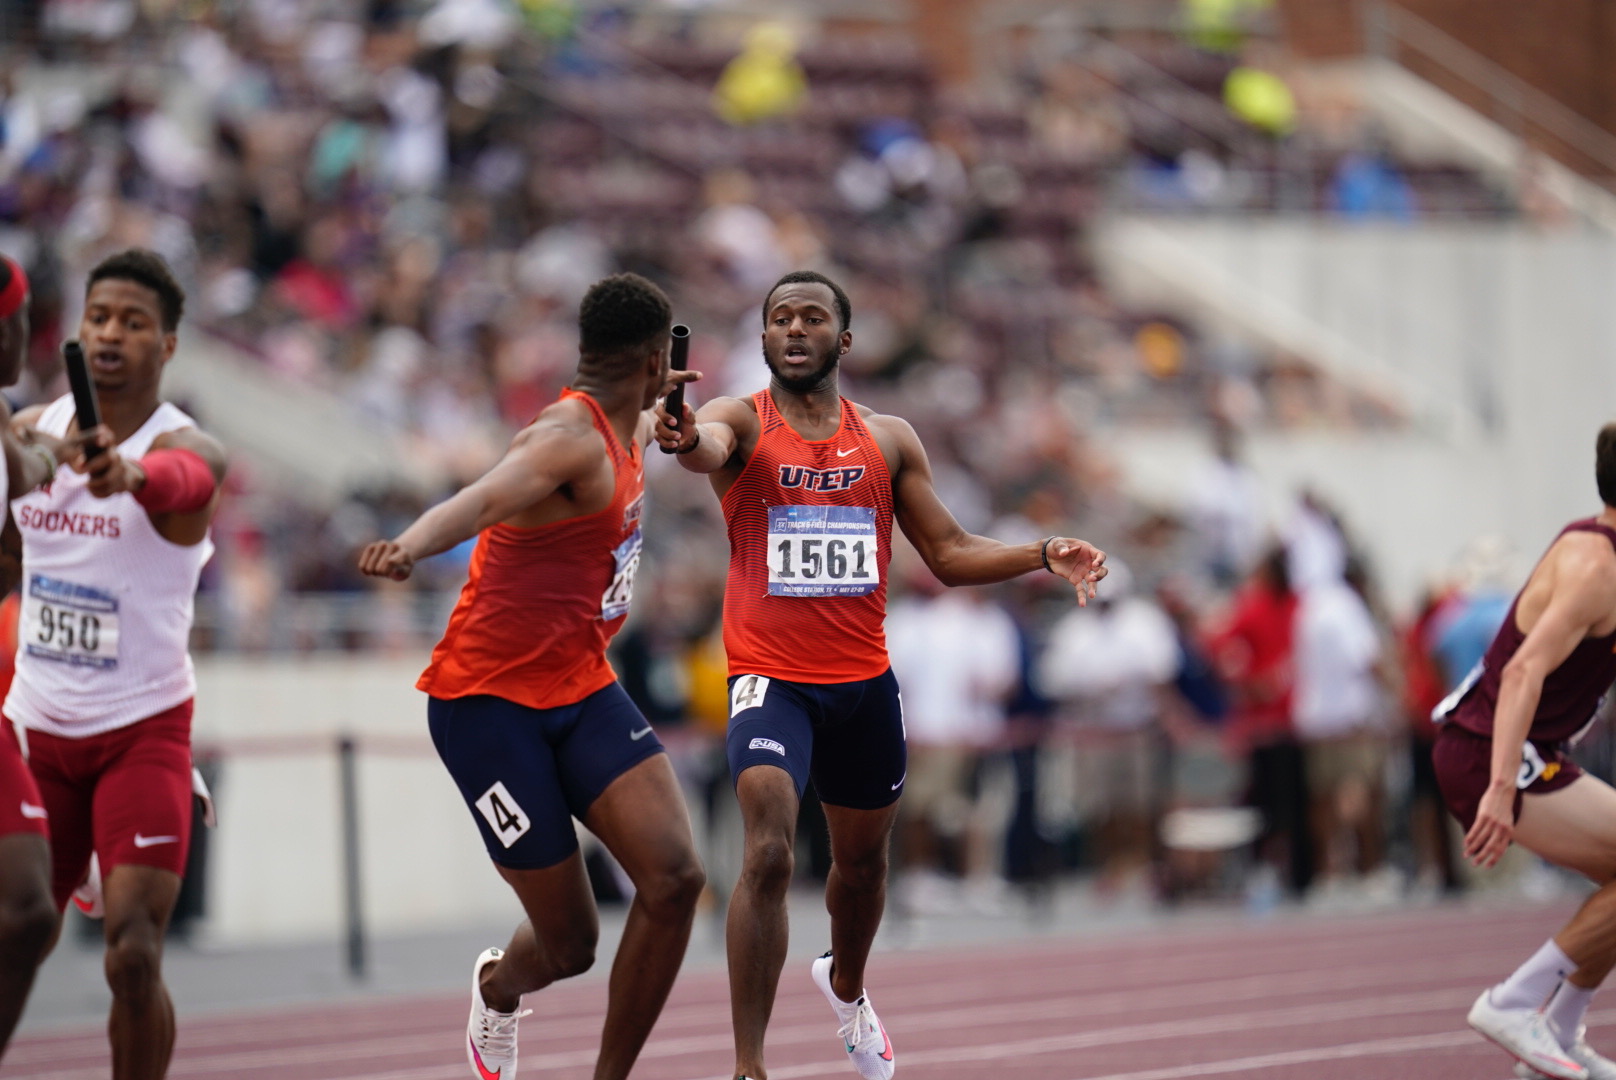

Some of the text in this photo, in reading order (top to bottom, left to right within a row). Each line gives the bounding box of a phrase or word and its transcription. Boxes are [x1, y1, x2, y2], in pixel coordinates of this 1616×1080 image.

[779, 464, 866, 492] UTEP
[20, 504, 121, 537] SOONERS
[787, 521, 806, 529] TRACK
[827, 522, 870, 530] CHAMPIONSHIPS
[778, 539, 870, 579] 1561
[38, 604, 101, 652] 950
[736, 676, 759, 706] 4
[489, 791, 522, 833] 4
